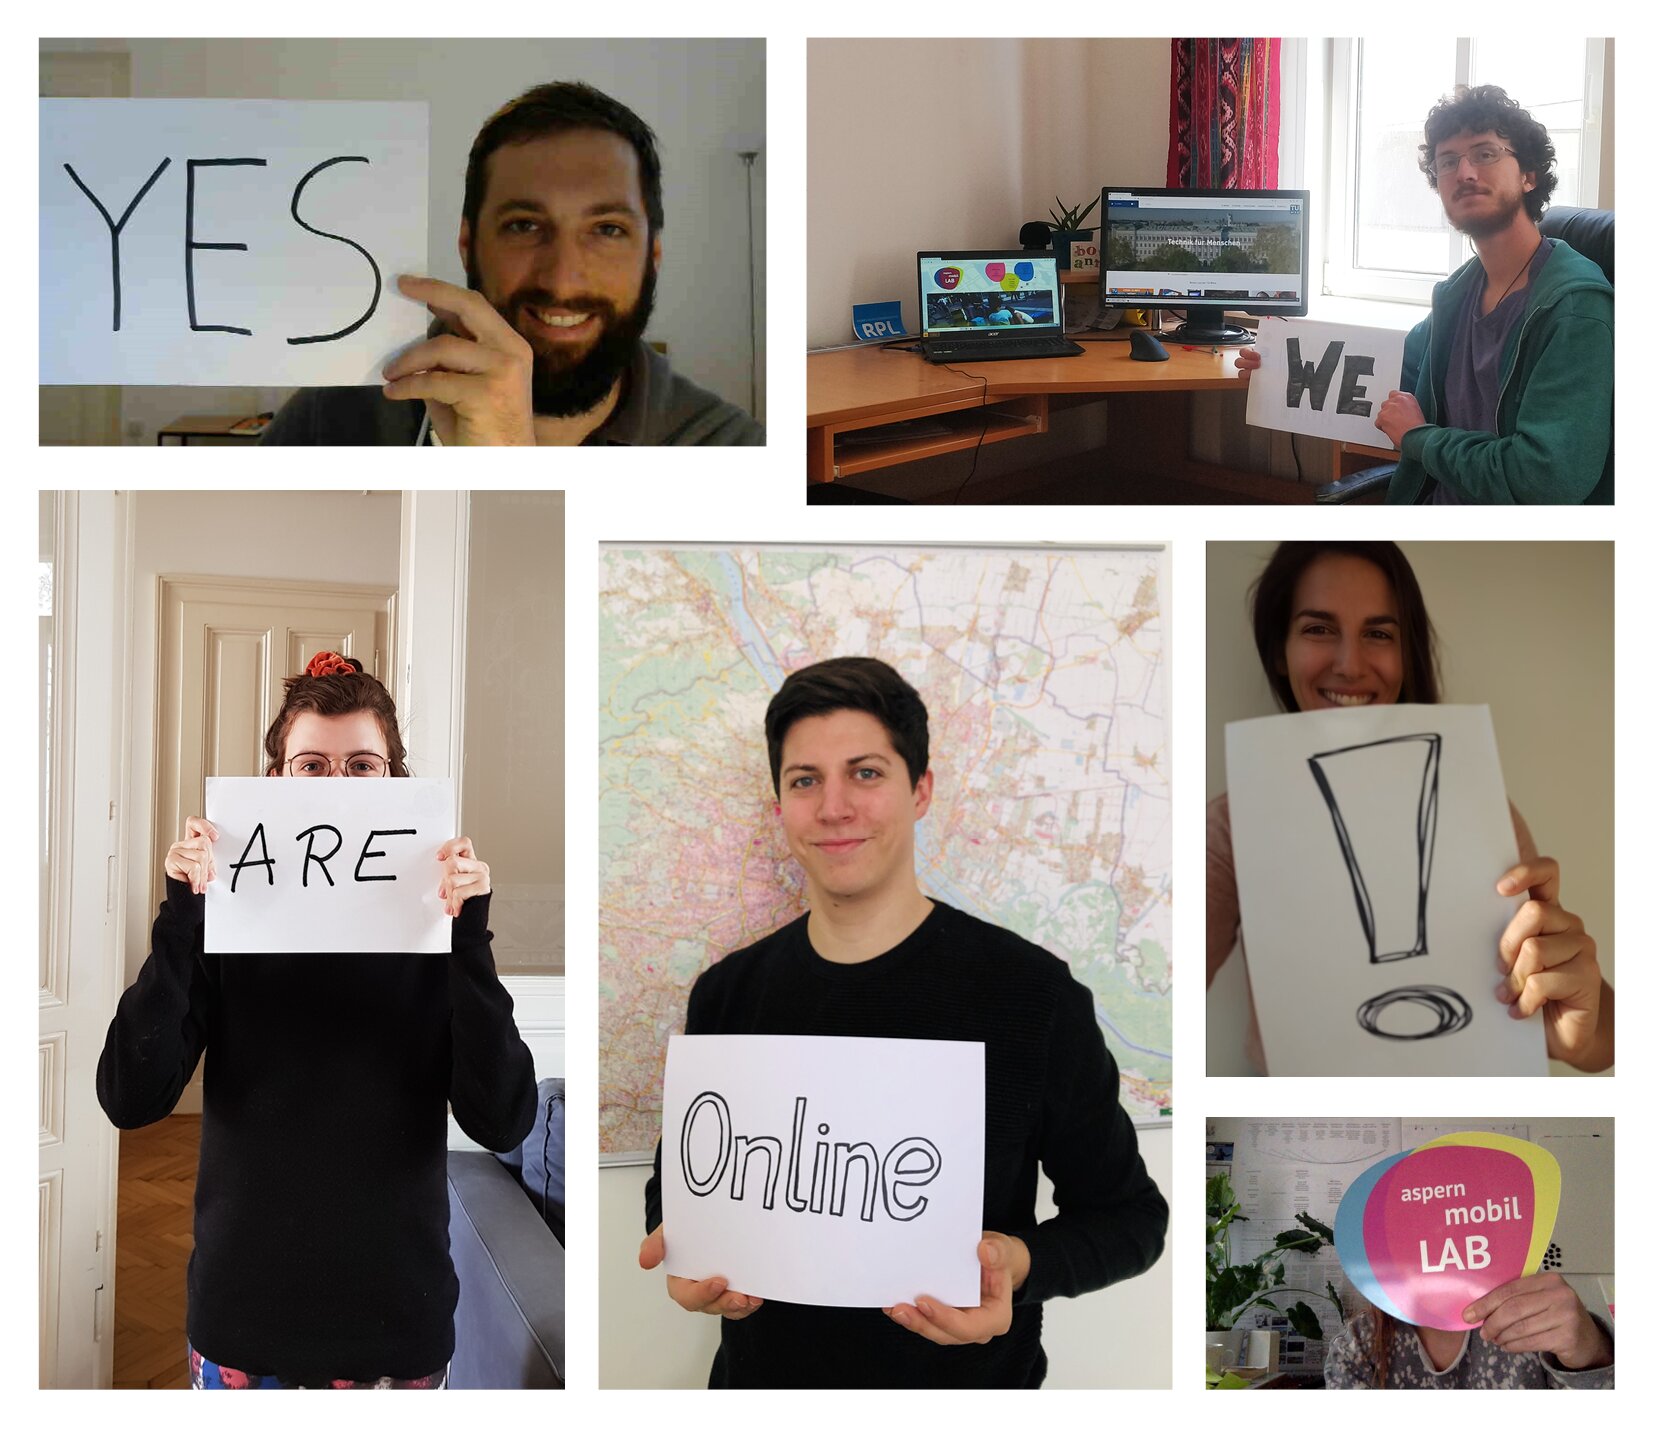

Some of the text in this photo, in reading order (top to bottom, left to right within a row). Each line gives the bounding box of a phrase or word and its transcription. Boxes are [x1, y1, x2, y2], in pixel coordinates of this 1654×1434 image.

[63, 154, 382, 346] YES
[1167, 238, 1194, 246] Technik
[1206, 239, 1241, 247] Menschen
[861, 320, 901, 338] RPL
[1286, 336, 1376, 419] WE
[229, 822, 417, 893] ARE
[1307, 732, 1474, 1041] !
[680, 1090, 942, 1224] Online
[1400, 1181, 1466, 1205] aspern
[1444, 1196, 1522, 1226] mobil
[1419, 1235, 1492, 1274] LAB
